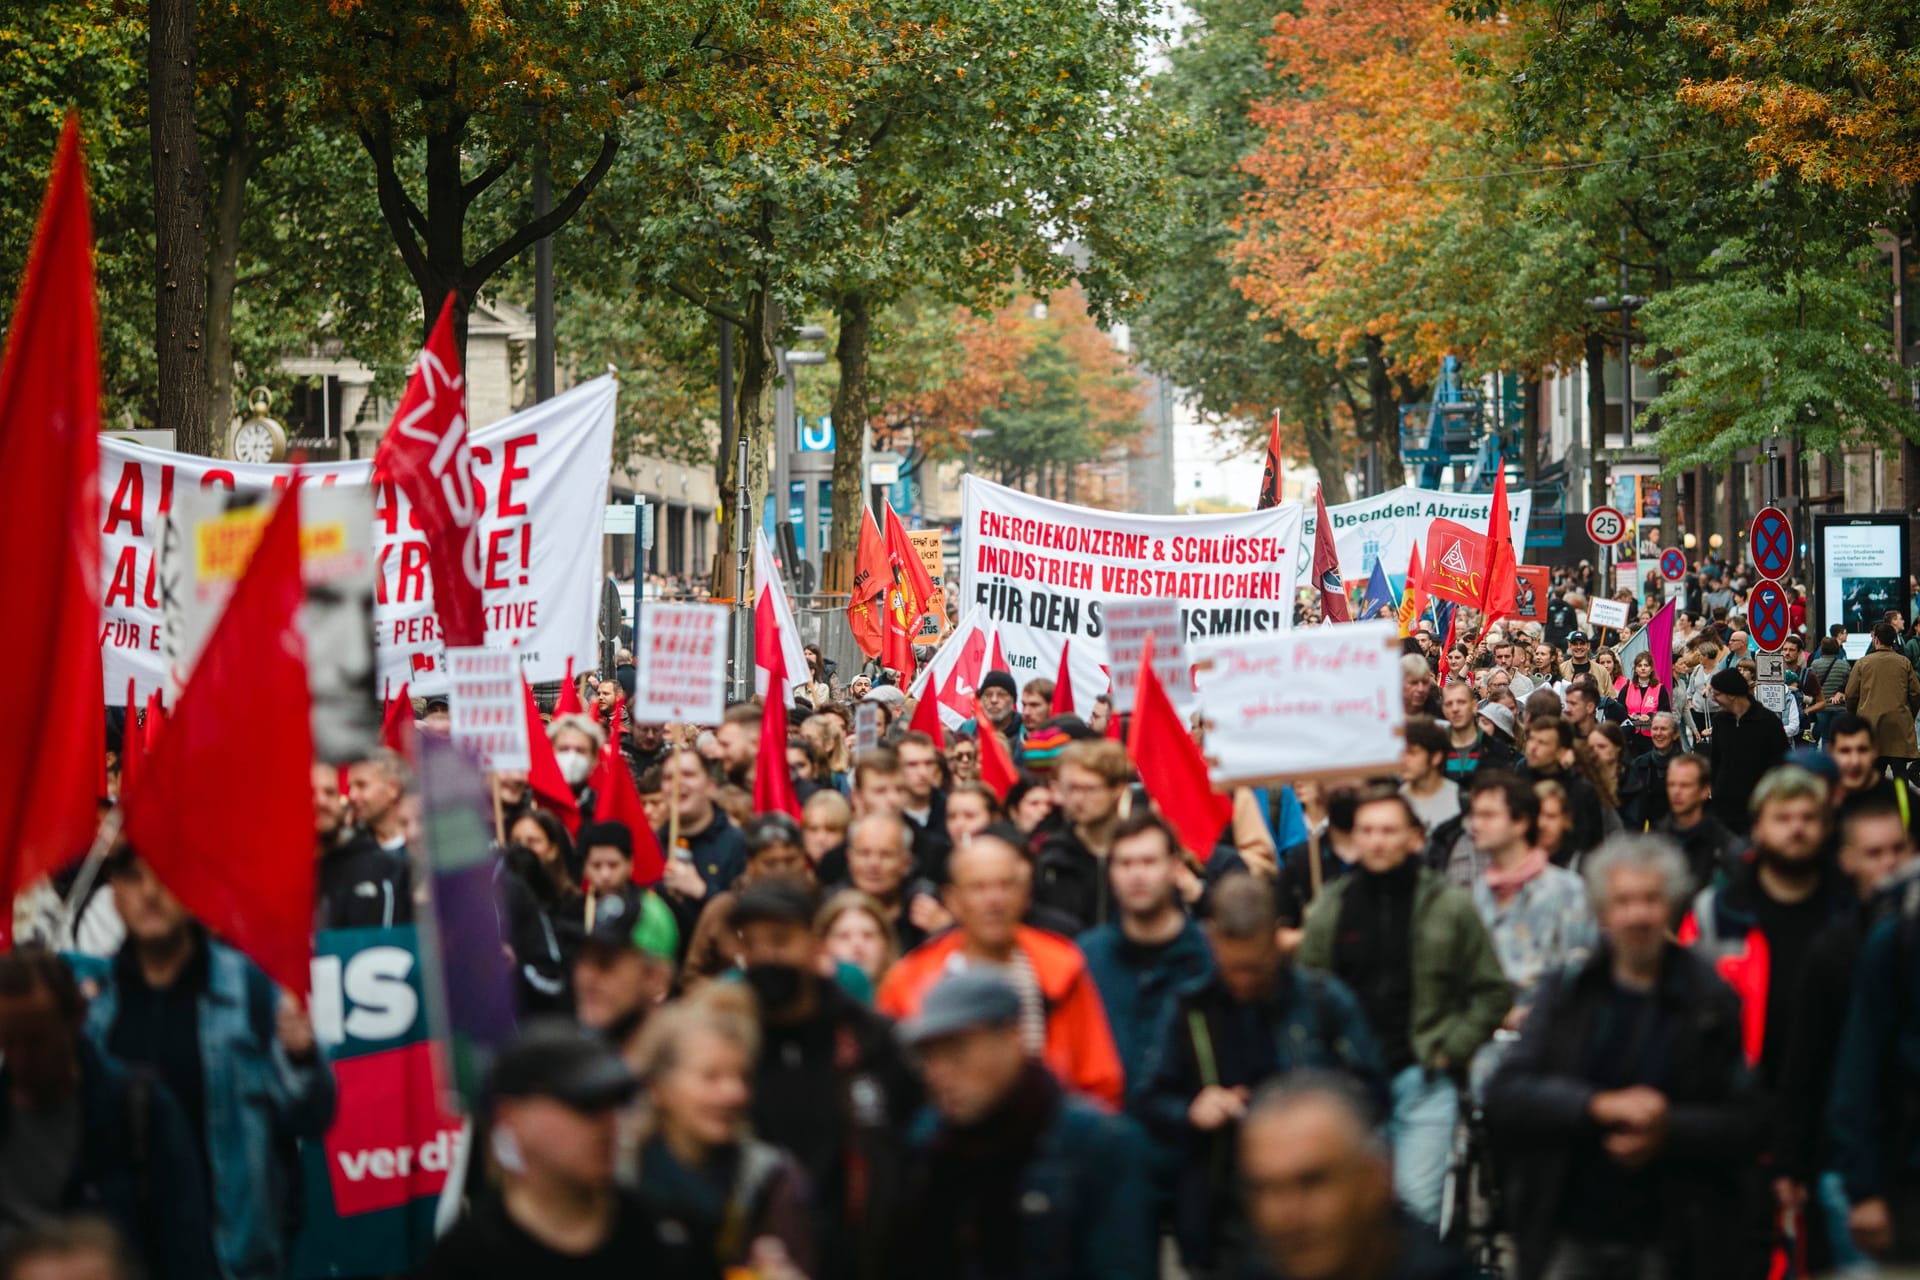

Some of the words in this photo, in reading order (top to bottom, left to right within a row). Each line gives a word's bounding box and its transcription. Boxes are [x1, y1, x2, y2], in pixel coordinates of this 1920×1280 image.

[979, 510, 1149, 560] ENERGIEKONZERNE
[1153, 540, 1165, 561] &
[1171, 534, 1286, 565] SCHLÜSSEL-
[1333, 502, 1421, 528] beenden!
[1425, 502, 1521, 522] Abrüst!
[1595, 516, 1618, 536] 25
[375, 522, 532, 605] KRE!
[911, 537, 928, 546] EHRT
[977, 545, 1094, 591] INDUSTRIEN
[1101, 566, 1281, 600] VERSTAATLICHEN!
[394, 600, 538, 646] PERKTIVE
[976, 577, 1023, 624] FÜR
[1029, 591, 1081, 635] DEN
[1085, 599, 1281, 645] SISMUS!
[1007, 650, 1038, 670] iv.net
